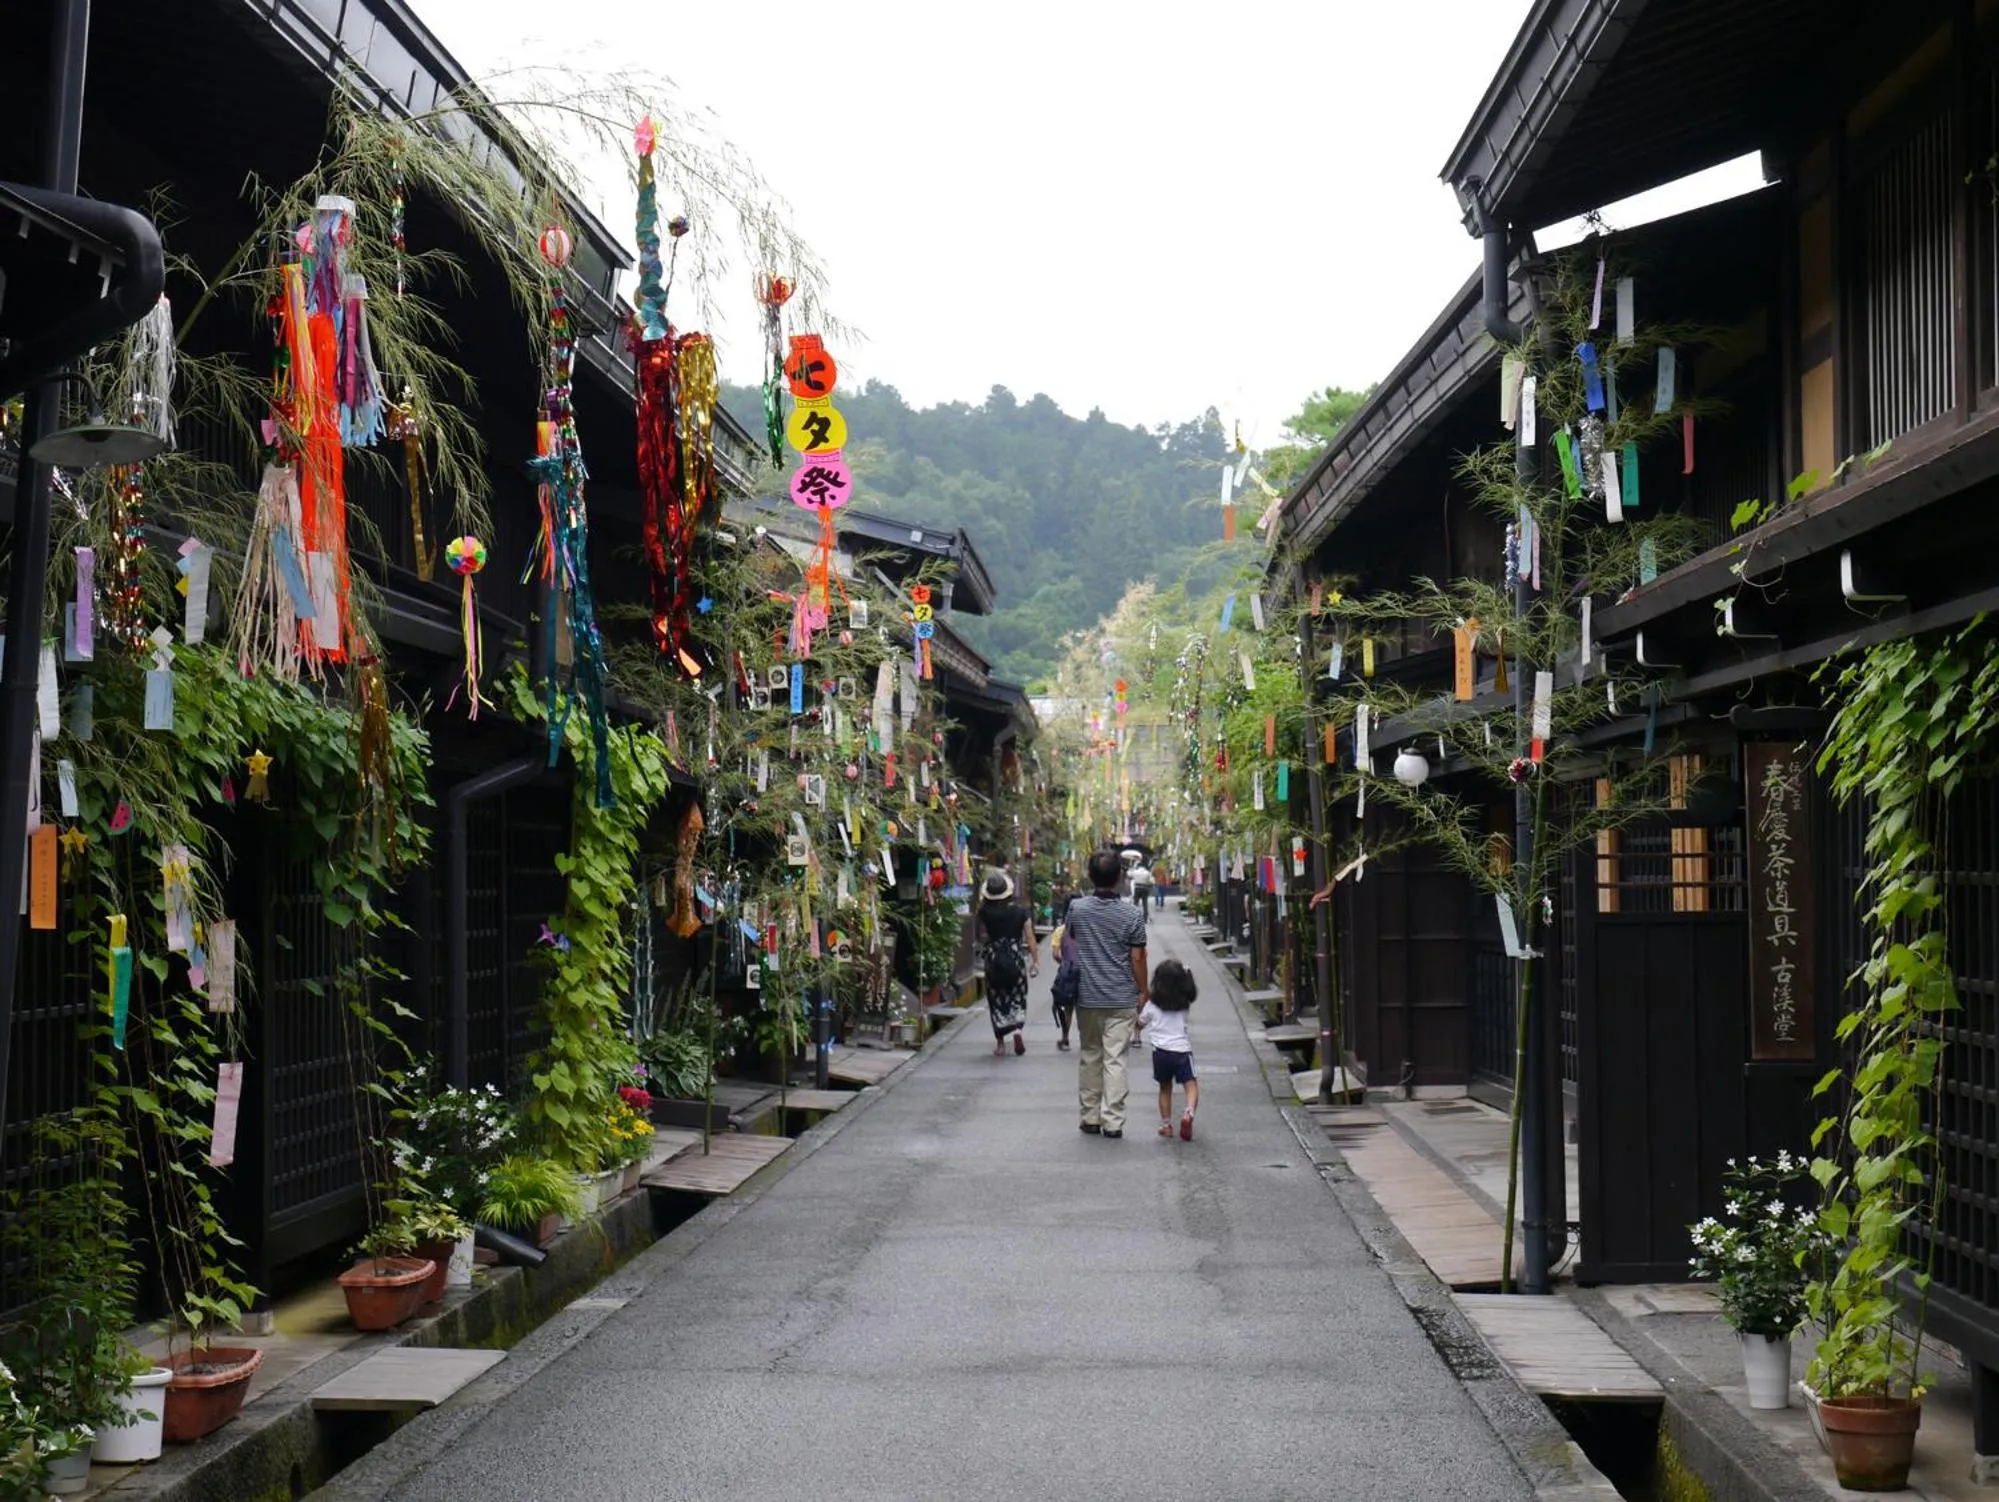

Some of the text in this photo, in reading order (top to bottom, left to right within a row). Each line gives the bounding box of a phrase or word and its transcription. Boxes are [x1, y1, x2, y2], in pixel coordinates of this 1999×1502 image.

[792, 355, 846, 507] 七夕祭
[914, 587, 932, 637] 七夕祭
